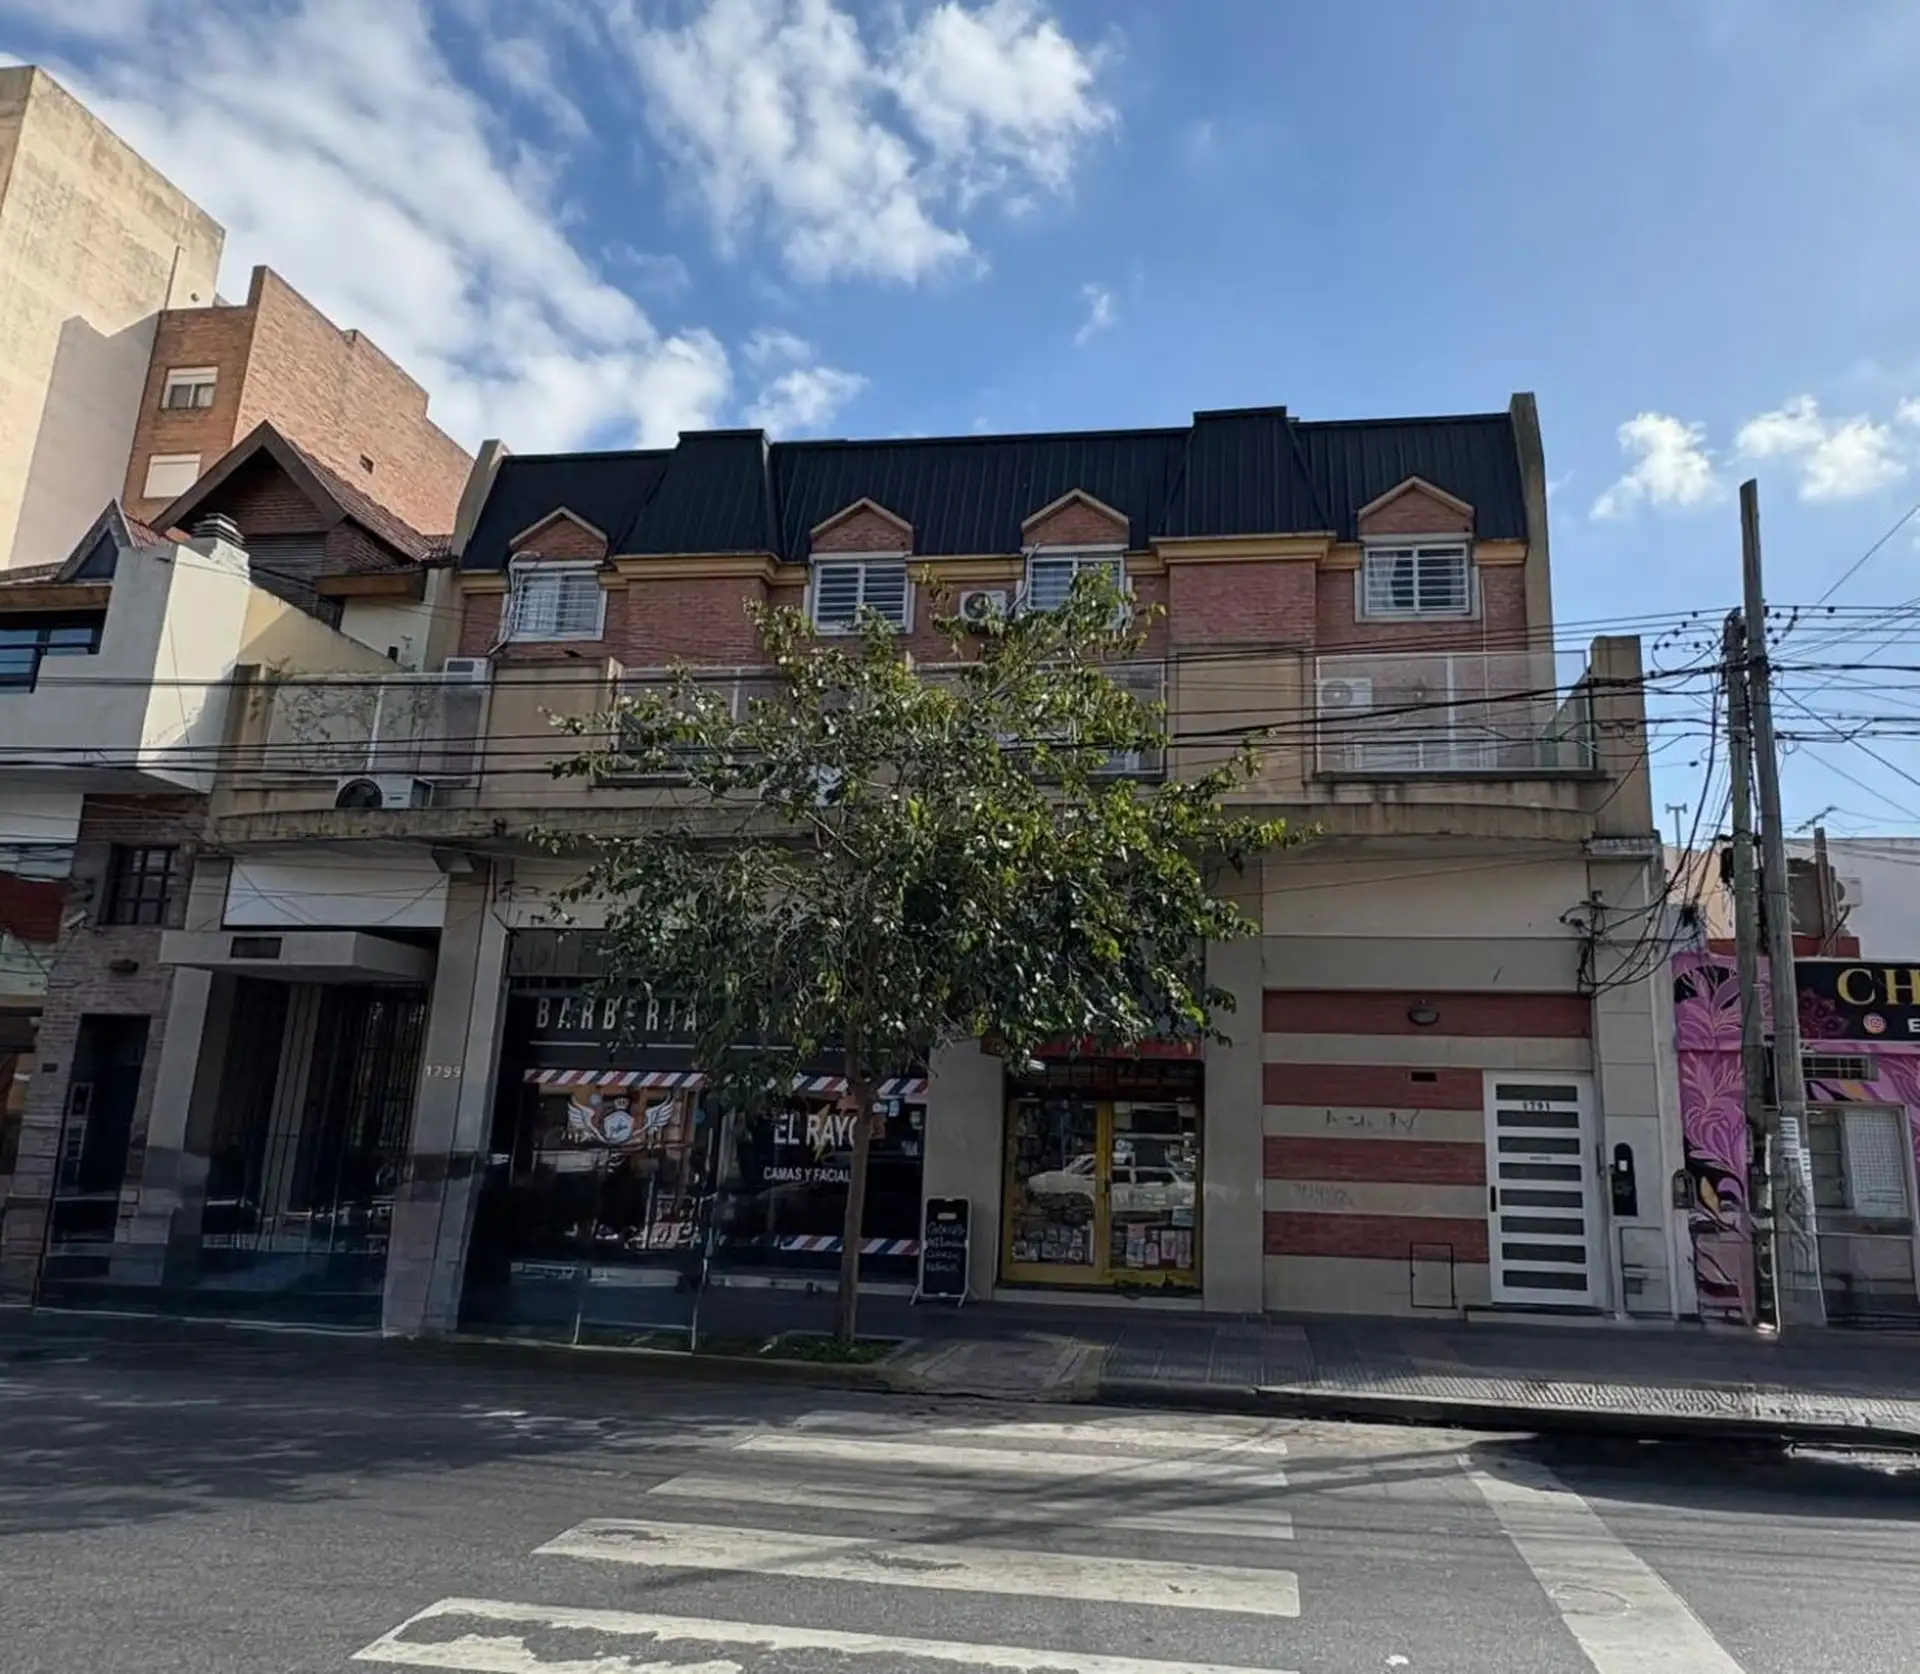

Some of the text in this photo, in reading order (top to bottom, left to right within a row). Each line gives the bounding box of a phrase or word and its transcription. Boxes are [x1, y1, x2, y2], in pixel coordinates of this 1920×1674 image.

[1836, 967, 1920, 1006] CH
[773, 1113, 800, 1145] EL
[763, 1166, 803, 1181] CAMAS
[803, 1167, 813, 1182] Y
